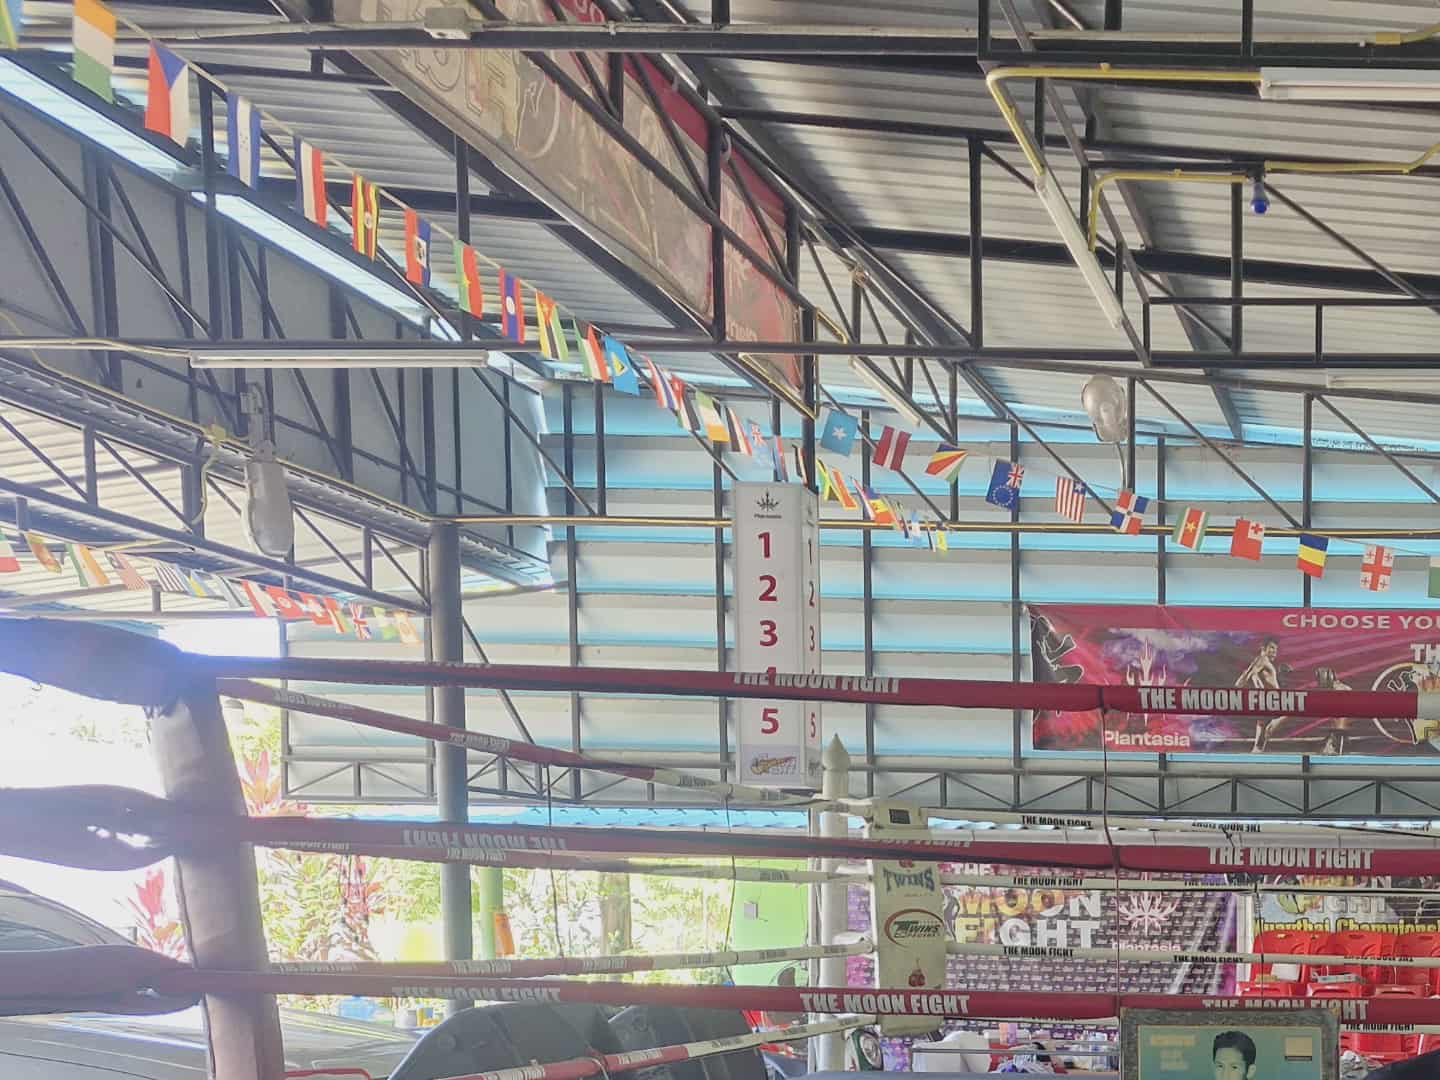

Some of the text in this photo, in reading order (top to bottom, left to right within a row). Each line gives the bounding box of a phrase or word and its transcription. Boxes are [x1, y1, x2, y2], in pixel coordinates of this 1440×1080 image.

[757, 531, 771, 558] 1
[808, 538, 812, 564] 1
[758, 574, 778, 602] 2
[808, 587, 815, 607] 2
[759, 619, 778, 647] 3
[1282, 613, 1391, 630] CHOOSE
[809, 625, 815, 651] 3
[775, 673, 836, 689] MOON
[1138, 687, 1308, 711] THE MOON FIGHT
[760, 708, 780, 734] 5
[810, 712, 816, 738] 5
[1104, 730, 1190, 748] Plantasia
[1021, 815, 1036, 825] THE
[1040, 816, 1064, 826] MOON
[1209, 846, 1374, 869] THE MOON FIGHT
[883, 867, 935, 892] TWINS
[1013, 876, 1028, 886] THE
[1030, 876, 1056, 887] MOON
[958, 888, 1100, 917] MOON
[954, 918, 1100, 950] FIGHT
[1003, 946, 1073, 957] THE MOON FIGHT
[800, 993, 970, 1014] THE MOON FIGHT
